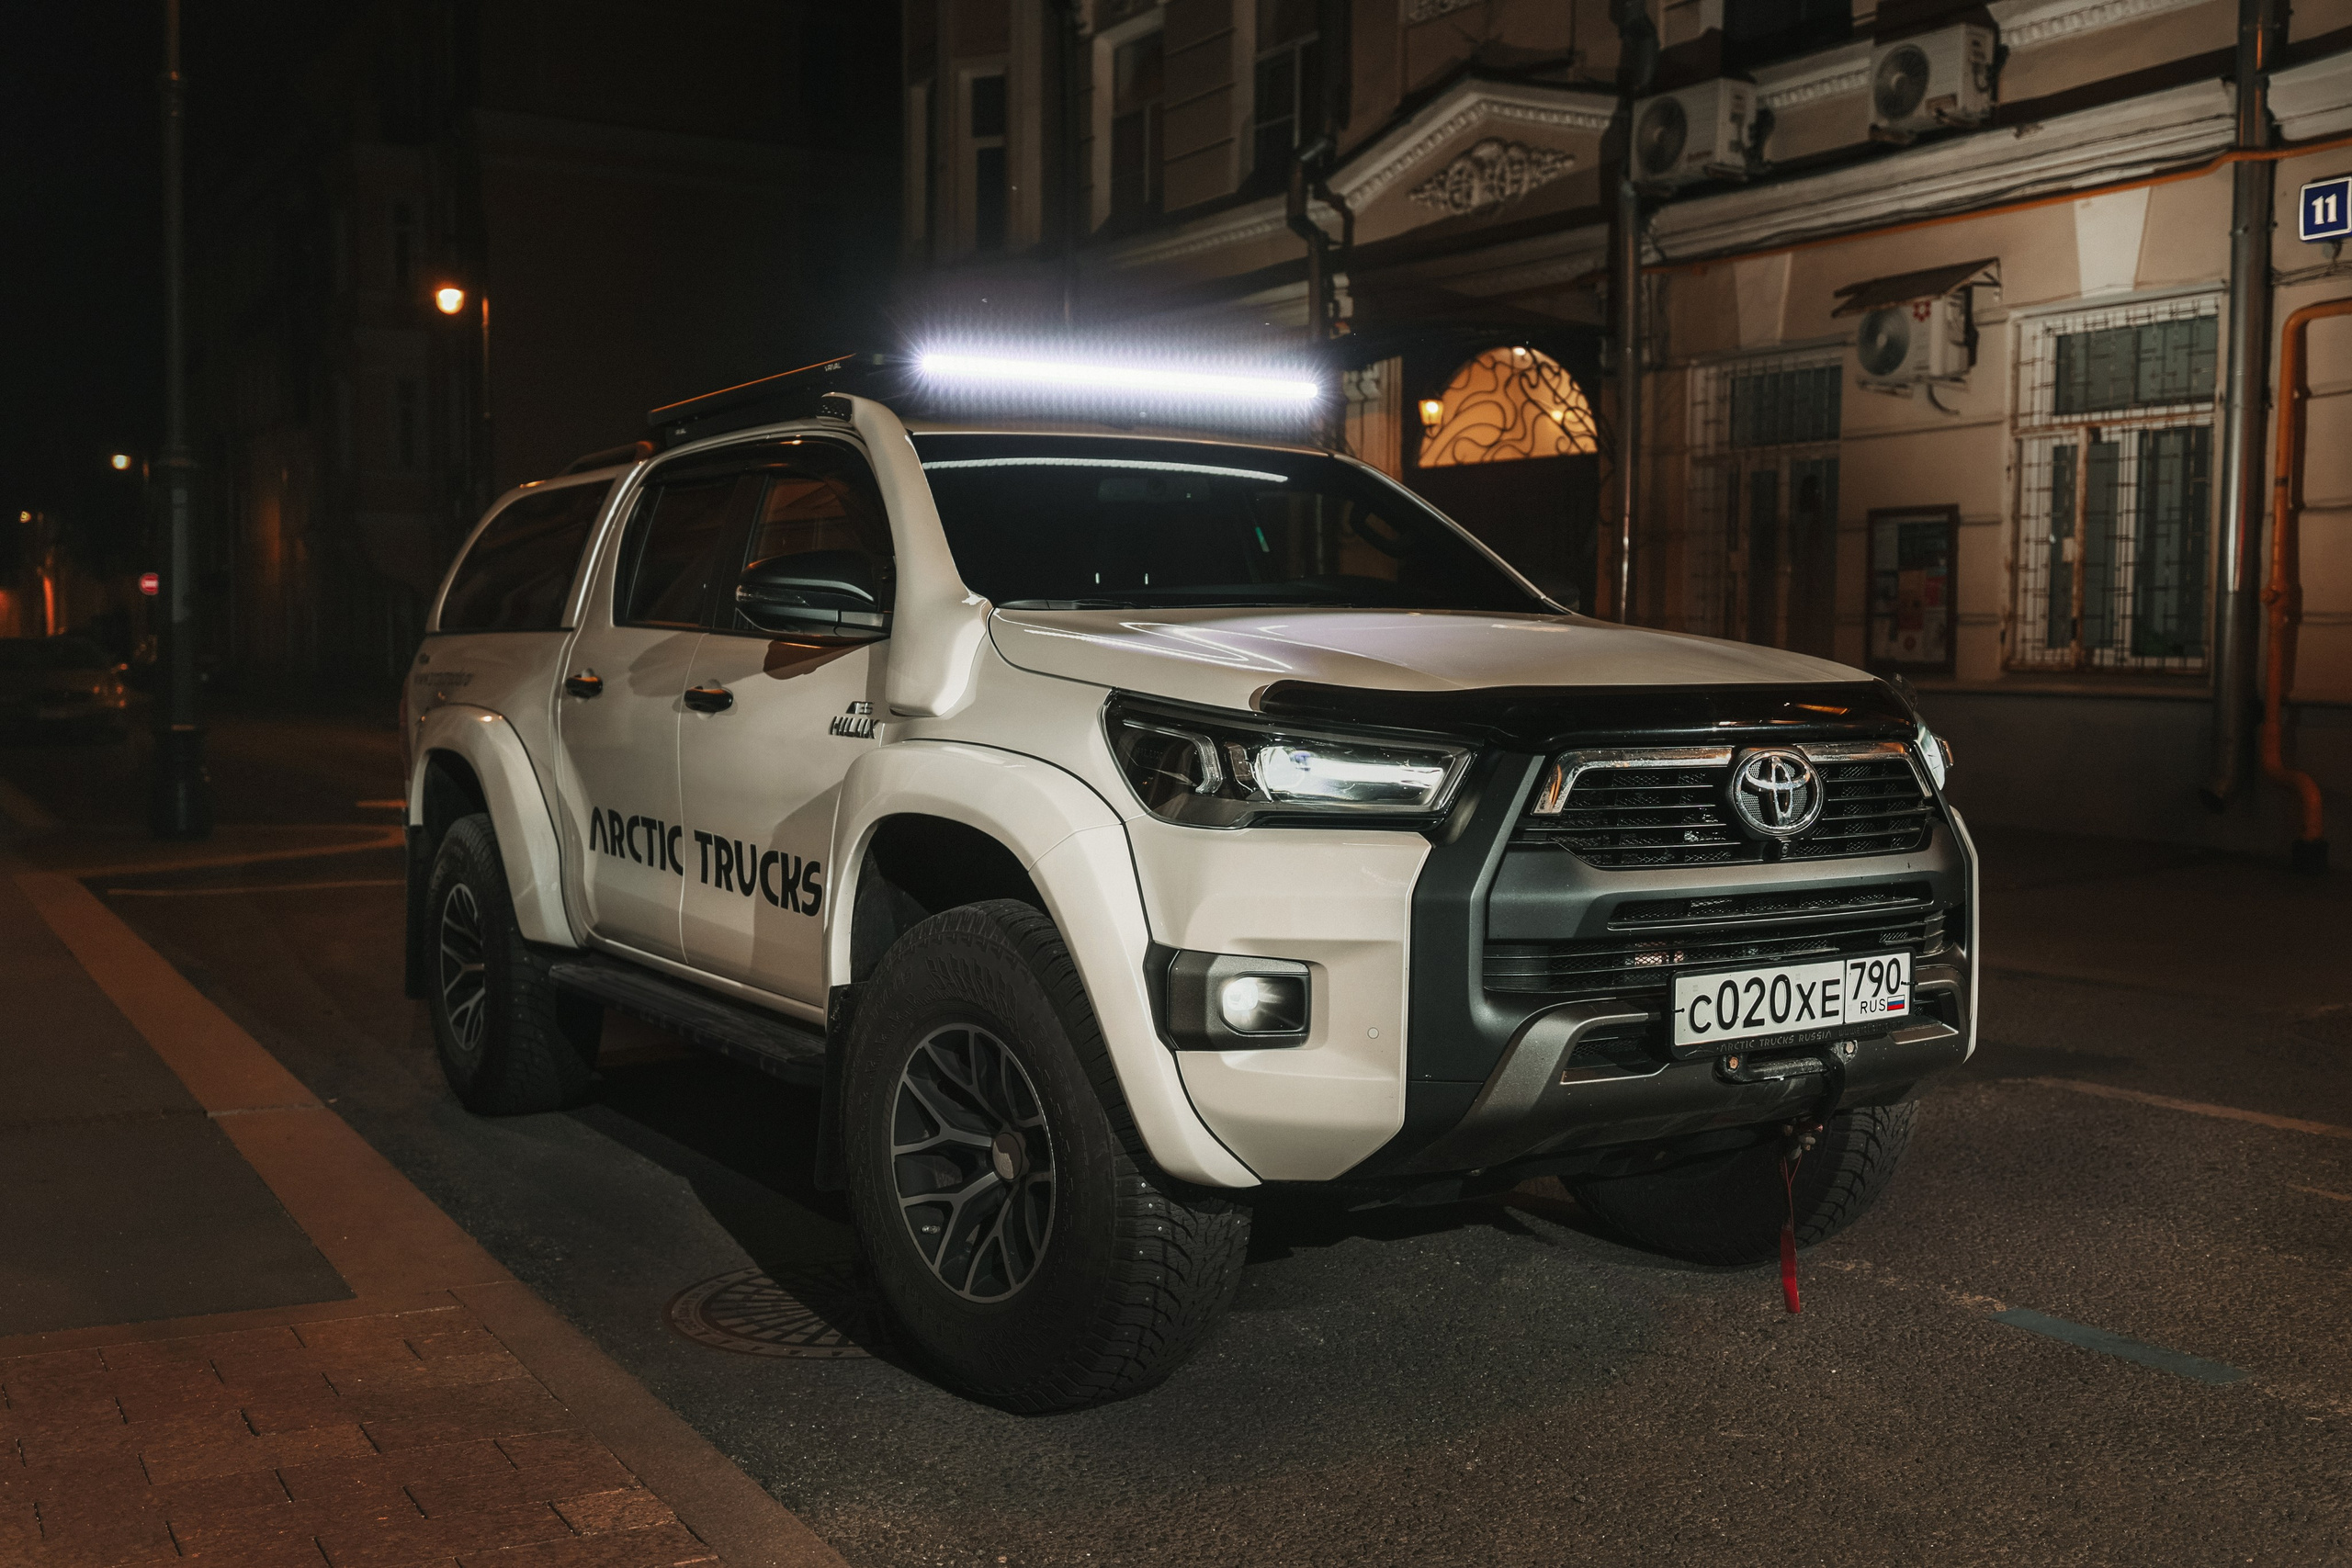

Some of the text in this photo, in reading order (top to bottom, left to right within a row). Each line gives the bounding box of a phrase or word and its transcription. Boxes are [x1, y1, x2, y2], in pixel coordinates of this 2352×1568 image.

[2312, 193, 2338, 225] 11
[589, 806, 823, 917] ARCTIC TRUCKS
[1849, 957, 1902, 1000] 790
[1860, 998, 1886, 1015] RUS
[1719, 1030, 1832, 1053] ARCTIC TRUCKS RUSSIA
